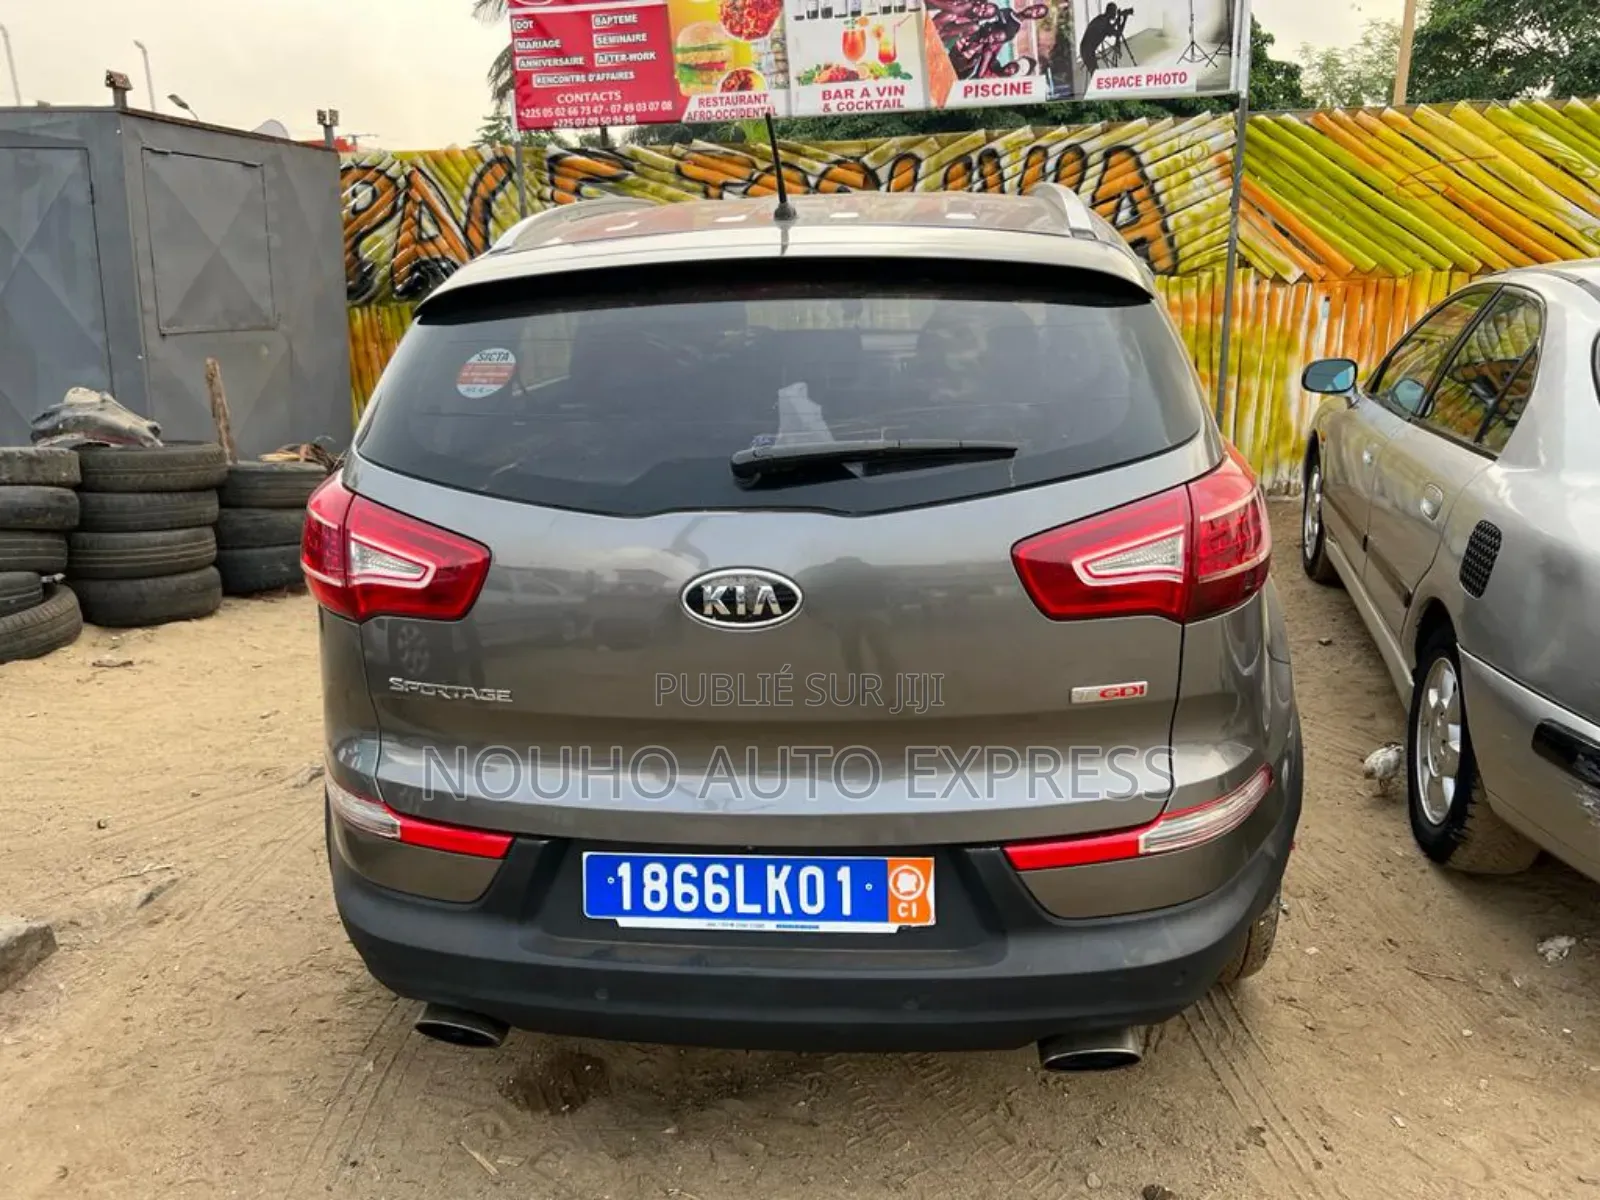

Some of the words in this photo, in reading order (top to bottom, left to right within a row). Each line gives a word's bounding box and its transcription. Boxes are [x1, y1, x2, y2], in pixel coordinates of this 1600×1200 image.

[594, 14, 638, 26] BAPTEME
[517, 39, 561, 50] MARIAGE
[596, 33, 647, 45] SEMINAIRE
[519, 56, 585, 68] ANNIVERSAIRE
[598, 52, 656, 63] AFTER-WORK
[536, 74, 586, 85] RENCONTRE
[588, 71, 635, 82] D'AFFAIRES
[1096, 75, 1142, 89] ESPACE
[1146, 72, 1188, 86] PHOTO
[822, 88, 854, 101] BAR
[859, 87, 871, 99] A
[876, 85, 905, 98] VIN
[963, 81, 1033, 98] PISCINE
[556, 91, 622, 104] CONTACTS
[698, 93, 768, 108] RESTAURANT
[520, 107, 541, 117] +225
[542, 107, 553, 117] 05
[554, 106, 565, 117] 02
[567, 106, 579, 116] 66
[580, 105, 591, 116] 73
[593, 104, 603, 115] 47
[611, 104, 622, 114] 07
[623, 103, 634, 113] 49
[636, 102, 647, 112] 03
[649, 101, 661, 112] 07
[661, 100, 673, 111] 08
[822, 102, 832, 113] &
[836, 98, 905, 112] COCKTAIL
[686, 106, 778, 120] AFRO-OCCIDENTAL
[553, 117, 573, 128] +225
[600, 115, 612, 126] 50
[702, 585, 783, 616] KIA
[388, 676, 513, 703] SPORTAGE
[1099, 685, 1145, 699] GDI
[617, 861, 851, 916] 1866LK01
[897, 902, 917, 919] CI
